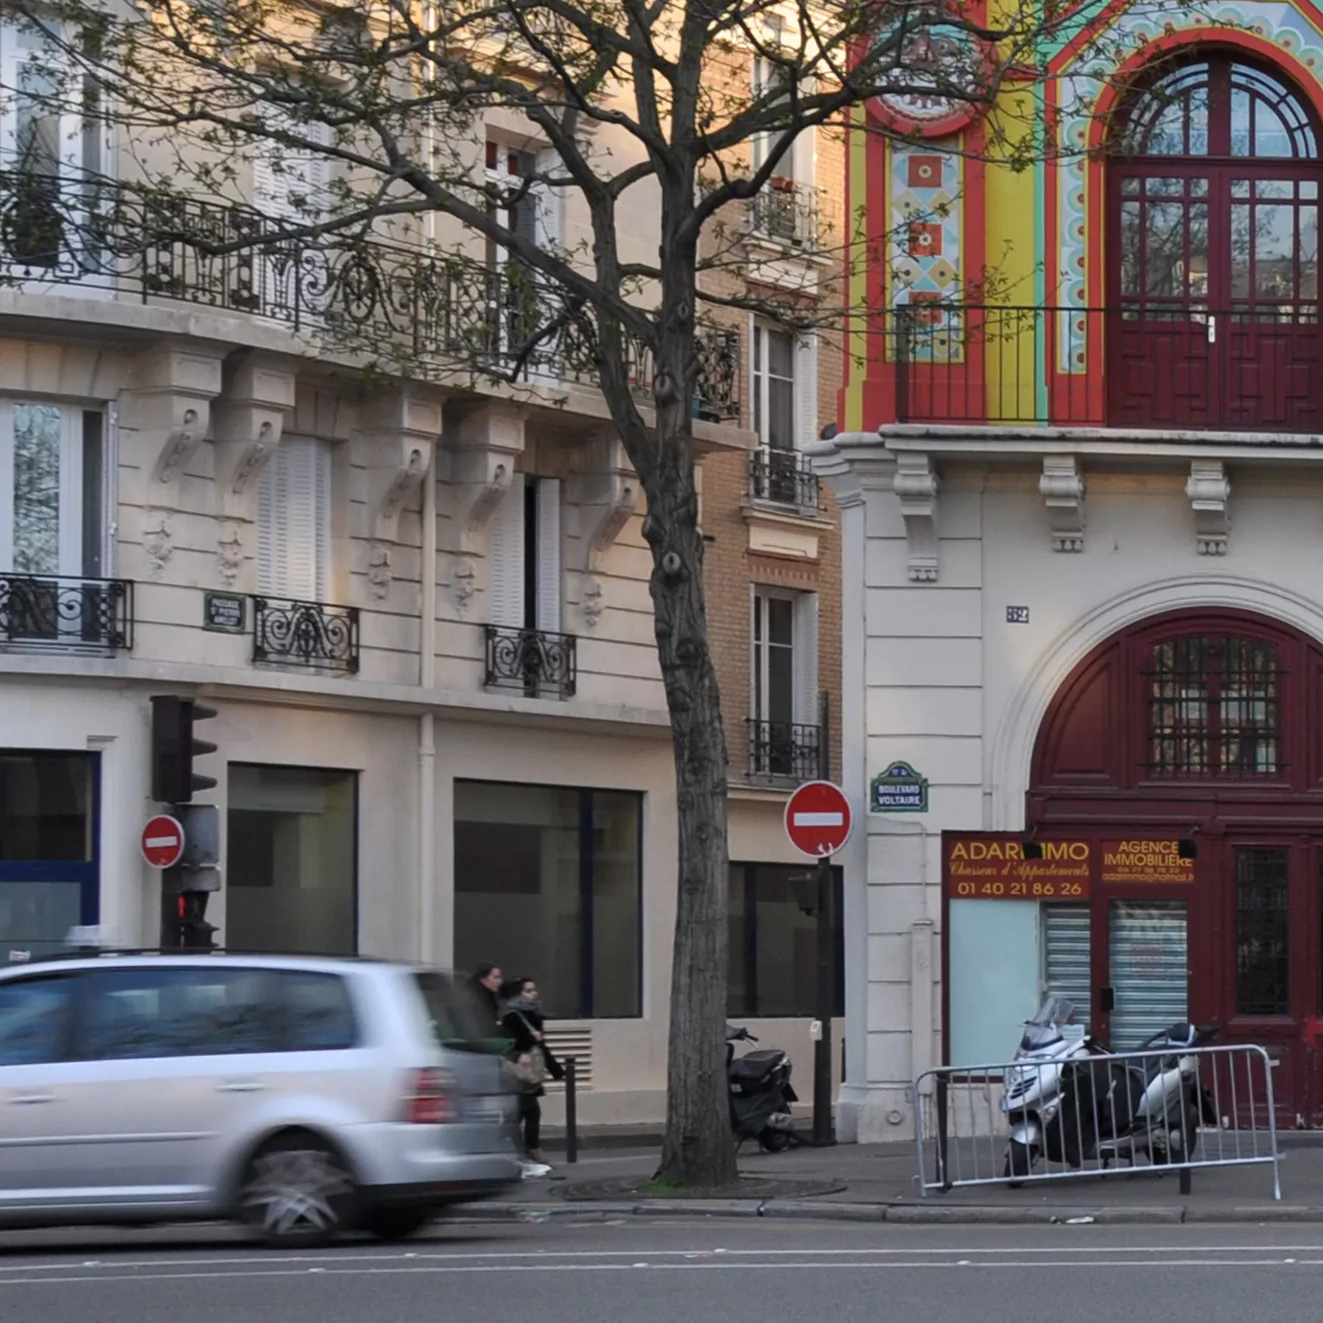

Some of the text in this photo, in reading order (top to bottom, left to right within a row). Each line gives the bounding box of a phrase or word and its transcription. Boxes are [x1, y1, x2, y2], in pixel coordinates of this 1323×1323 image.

[878, 784, 920, 794] BOULEVARD
[878, 795, 921, 805] VOLTAIRE
[1118, 840, 1179, 854] AGENCE
[957, 882, 1082, 895] 01 40 21 86 26
